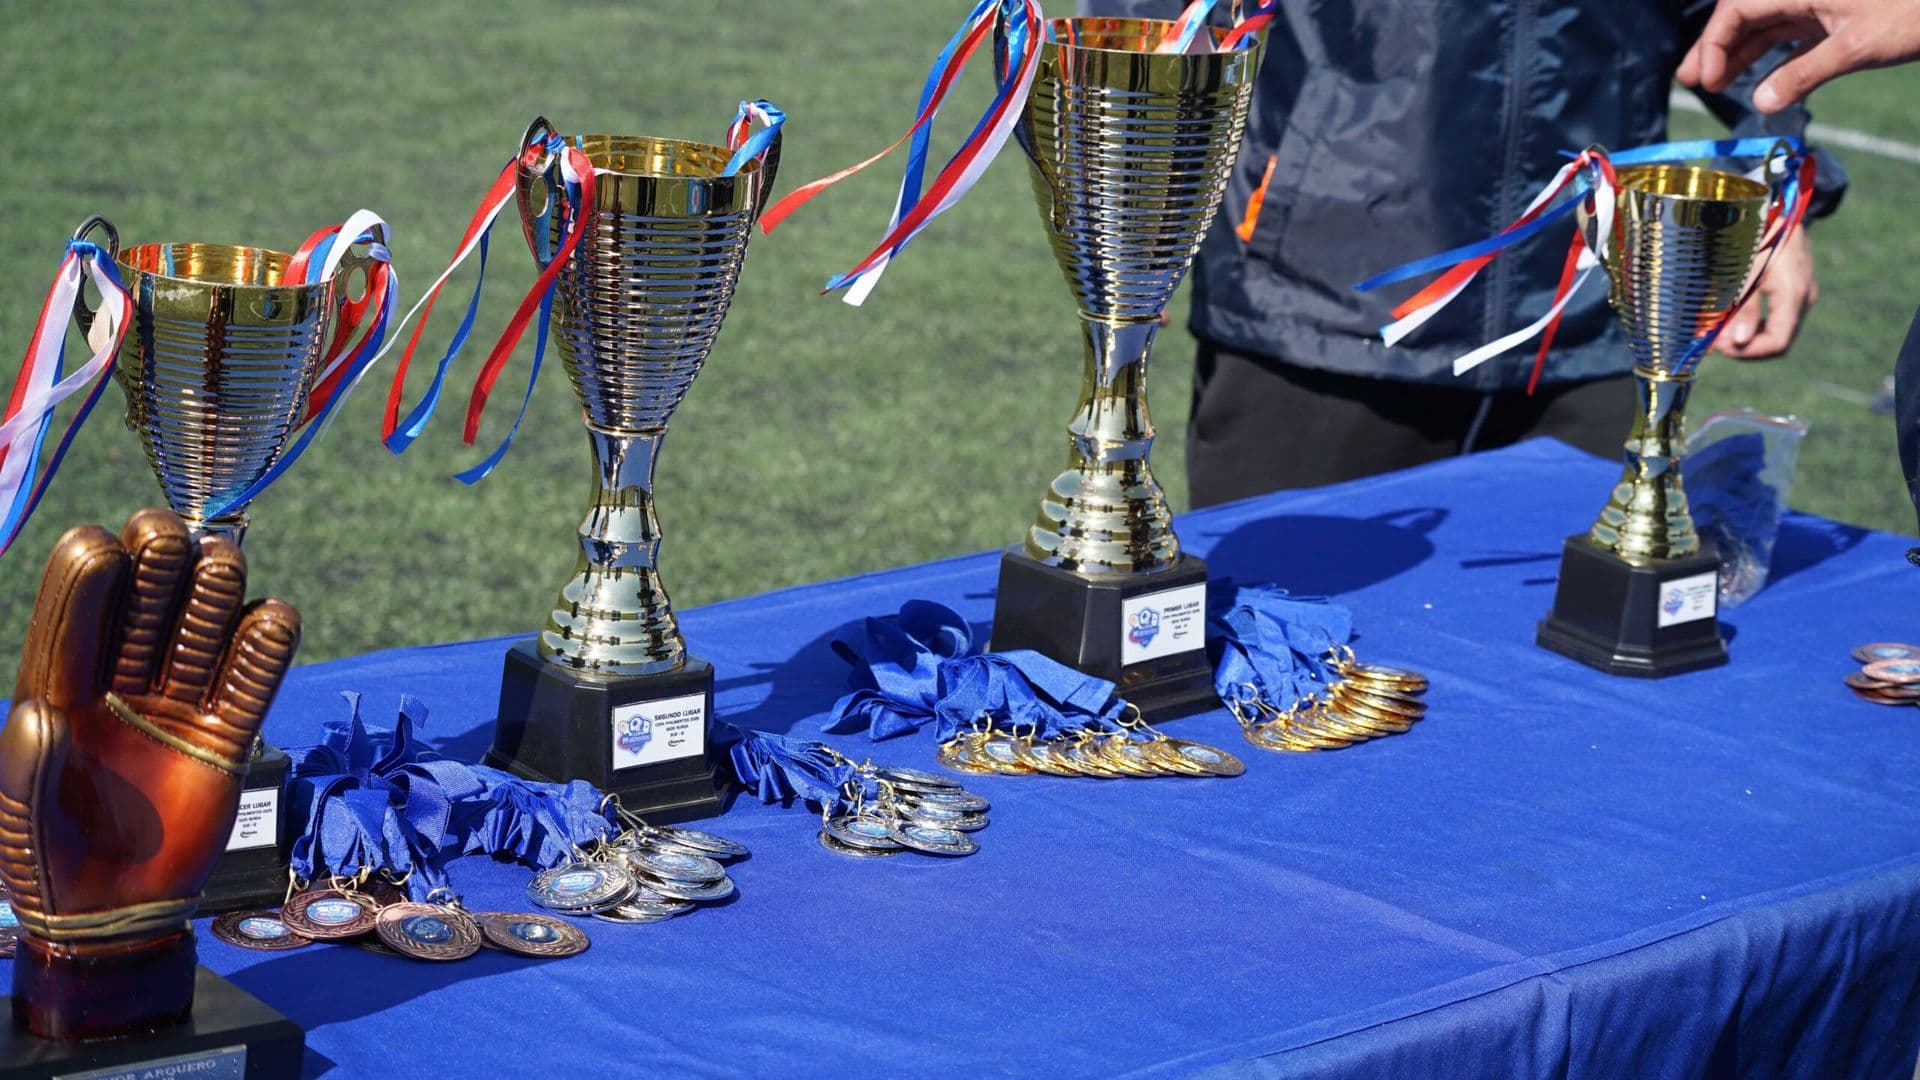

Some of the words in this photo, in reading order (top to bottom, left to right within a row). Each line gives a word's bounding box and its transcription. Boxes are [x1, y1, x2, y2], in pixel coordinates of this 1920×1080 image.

[654, 712, 682, 721] SEGUNDO
[683, 708, 701, 716] LUGAR
[253, 801, 271, 809] LUGAR
[144, 1059, 217, 1079] ARQUERO
